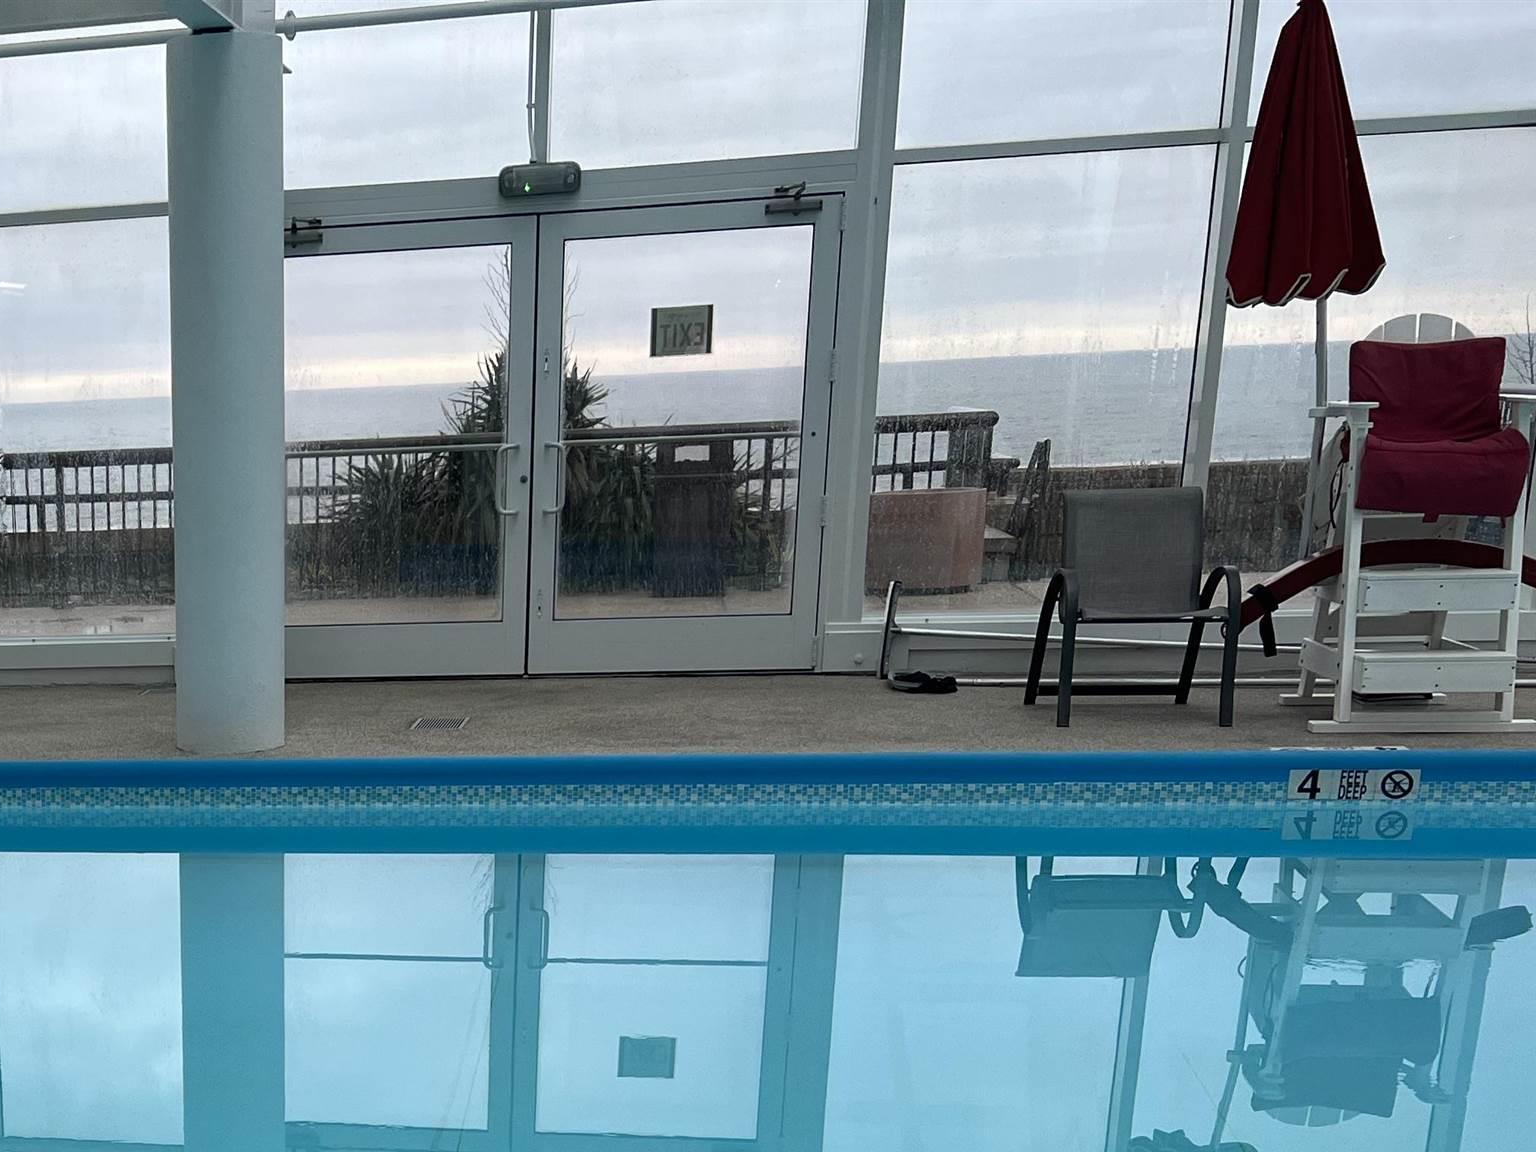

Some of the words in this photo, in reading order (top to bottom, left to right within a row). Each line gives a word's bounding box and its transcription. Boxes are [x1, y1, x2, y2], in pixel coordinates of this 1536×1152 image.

[1296, 769, 1321, 800] 4
[1340, 769, 1369, 785] FEET
[1337, 784, 1368, 800] DEEP
